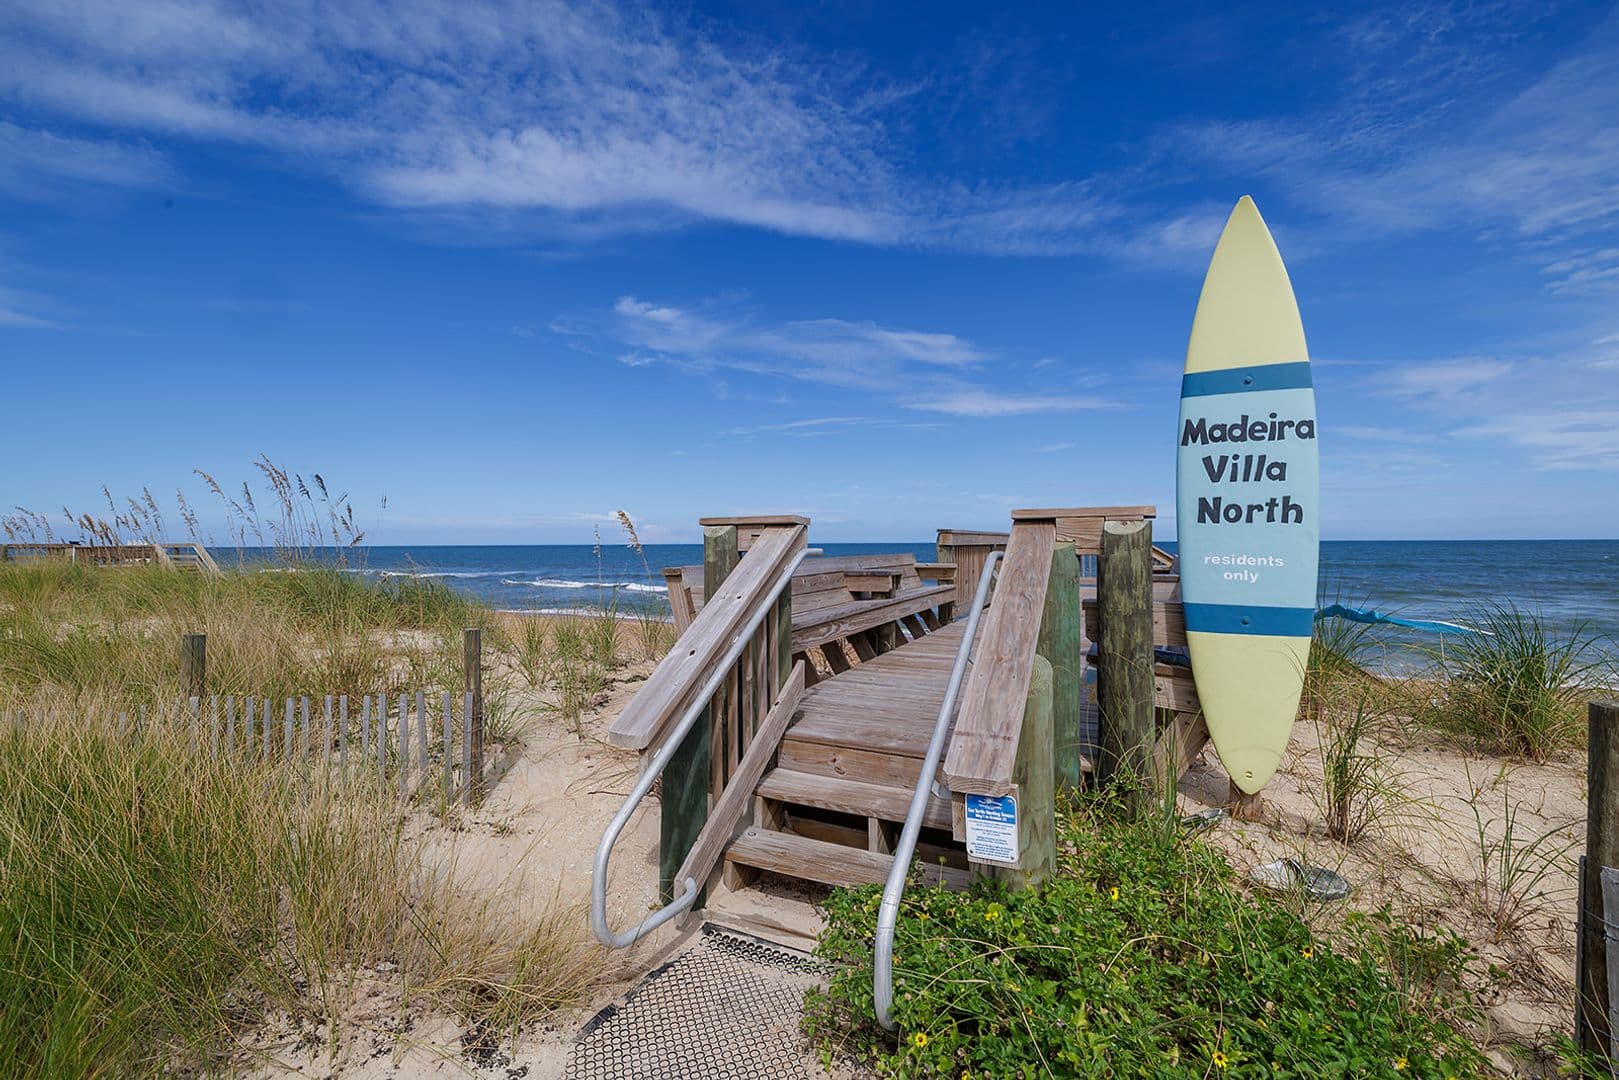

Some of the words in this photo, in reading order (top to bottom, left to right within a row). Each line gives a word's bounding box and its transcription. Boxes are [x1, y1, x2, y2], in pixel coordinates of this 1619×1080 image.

[1181, 413, 1315, 446] Madeira
[1202, 454, 1287, 483] Villa
[1197, 496, 1303, 524] North
[1205, 555, 1284, 567] residents
[1224, 571, 1259, 583] only
